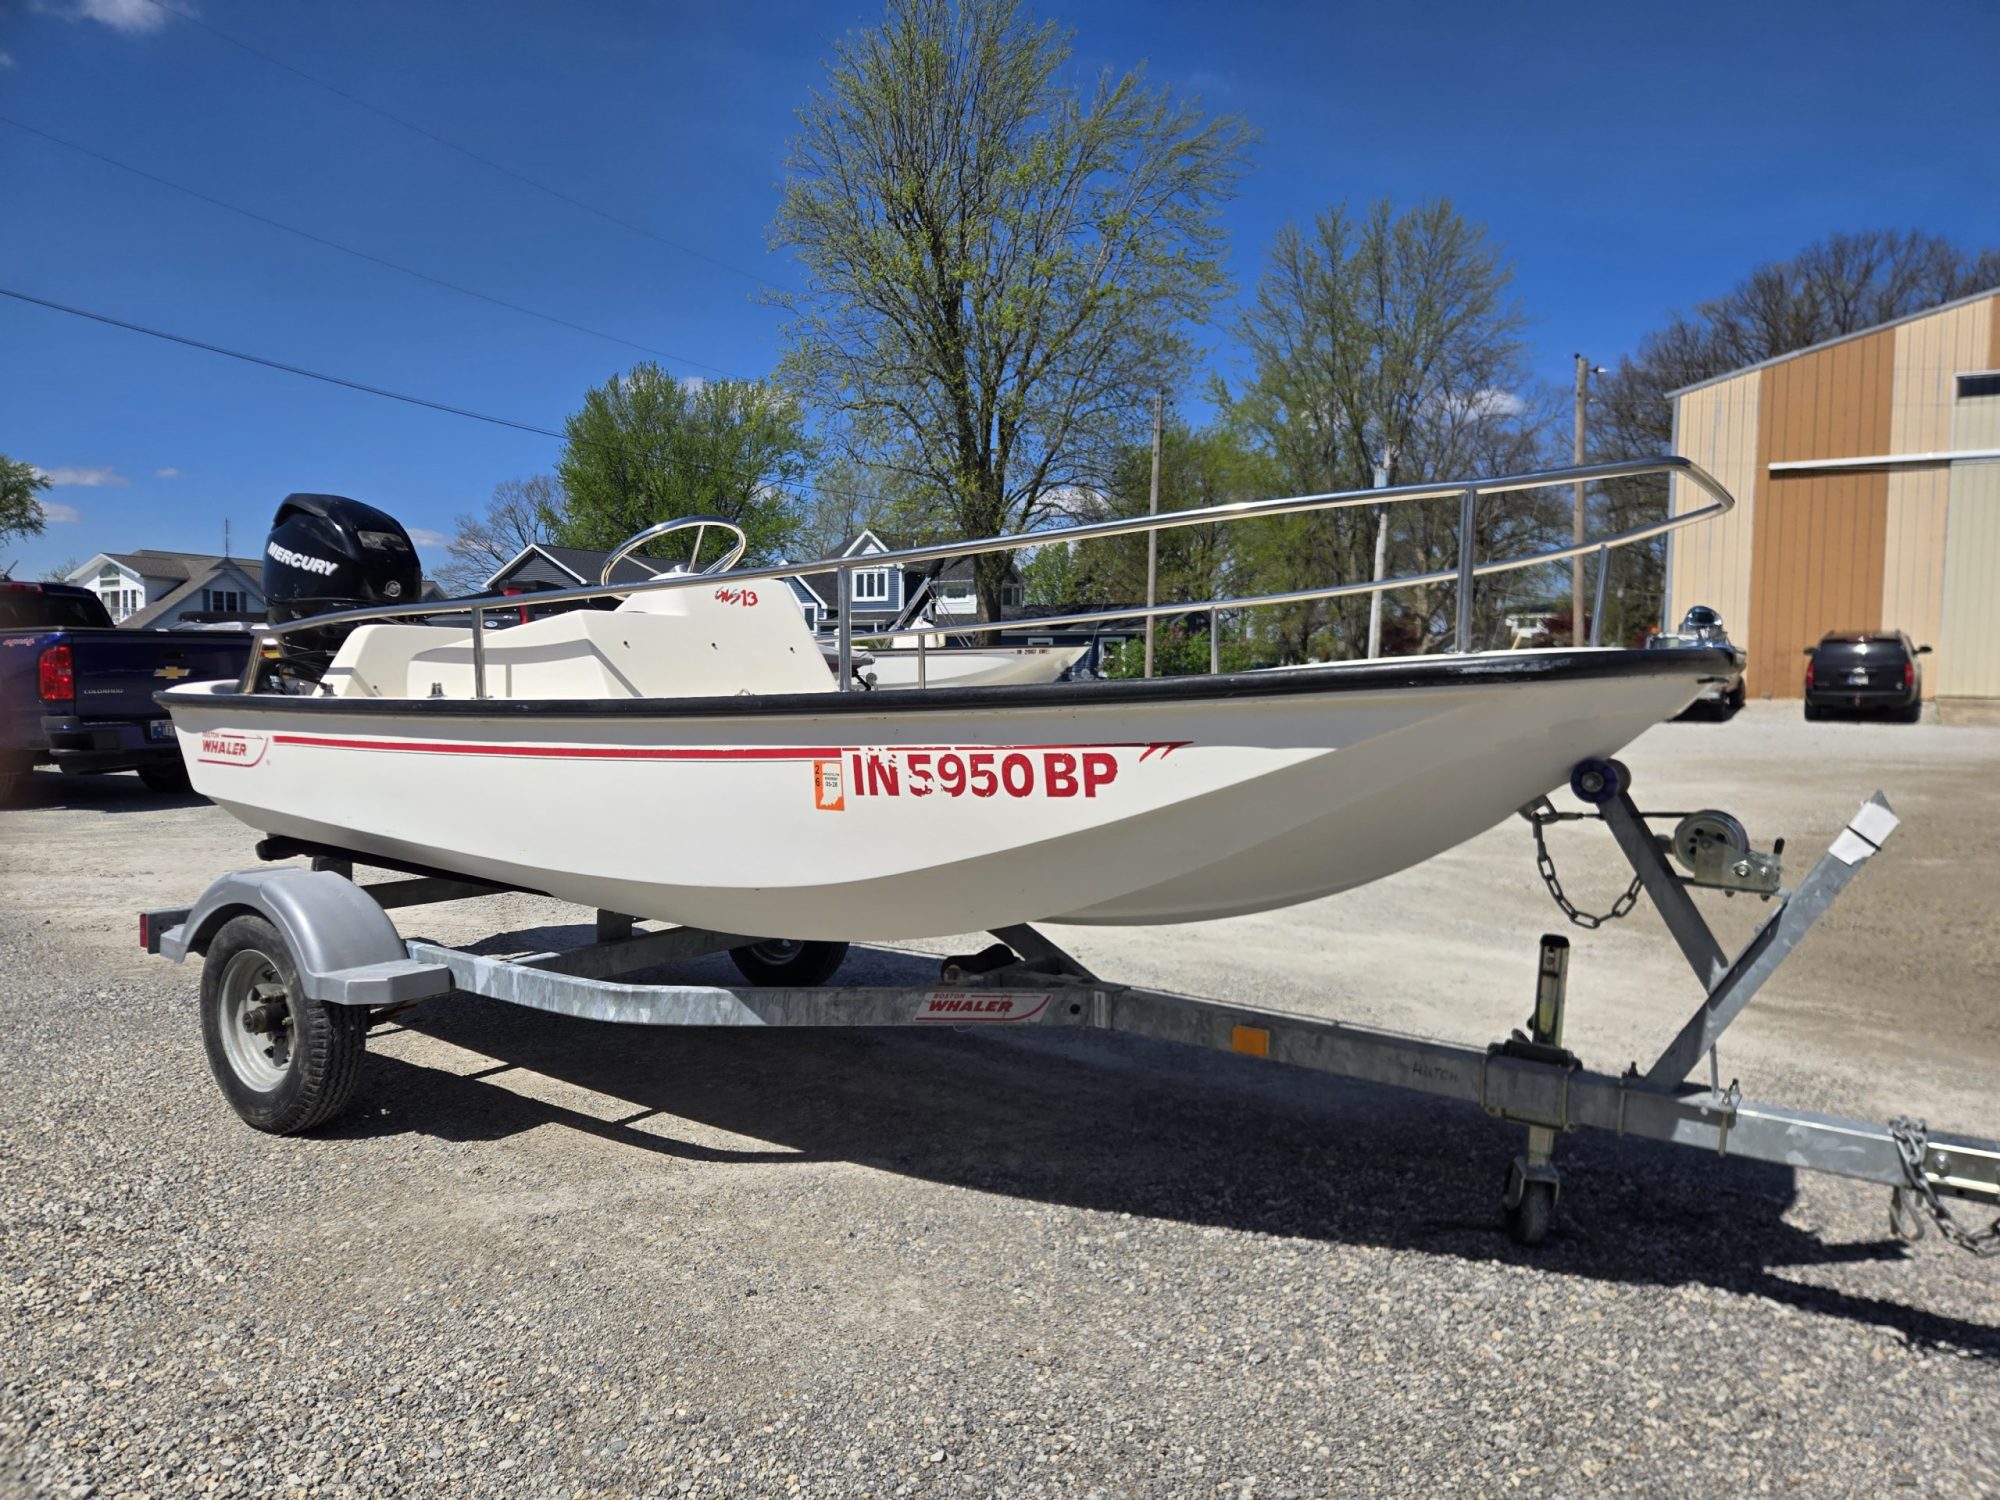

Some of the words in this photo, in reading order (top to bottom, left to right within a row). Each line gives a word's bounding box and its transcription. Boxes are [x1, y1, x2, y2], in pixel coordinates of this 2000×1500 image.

[267, 541, 339, 576] MERCURY
[741, 589, 759, 606] 13
[202, 740, 246, 756] WHALER
[852, 752, 900, 796] IN
[907, 752, 1035, 798] 5950
[1043, 752, 1118, 798] BP
[928, 1000, 1014, 1013] WHALER
